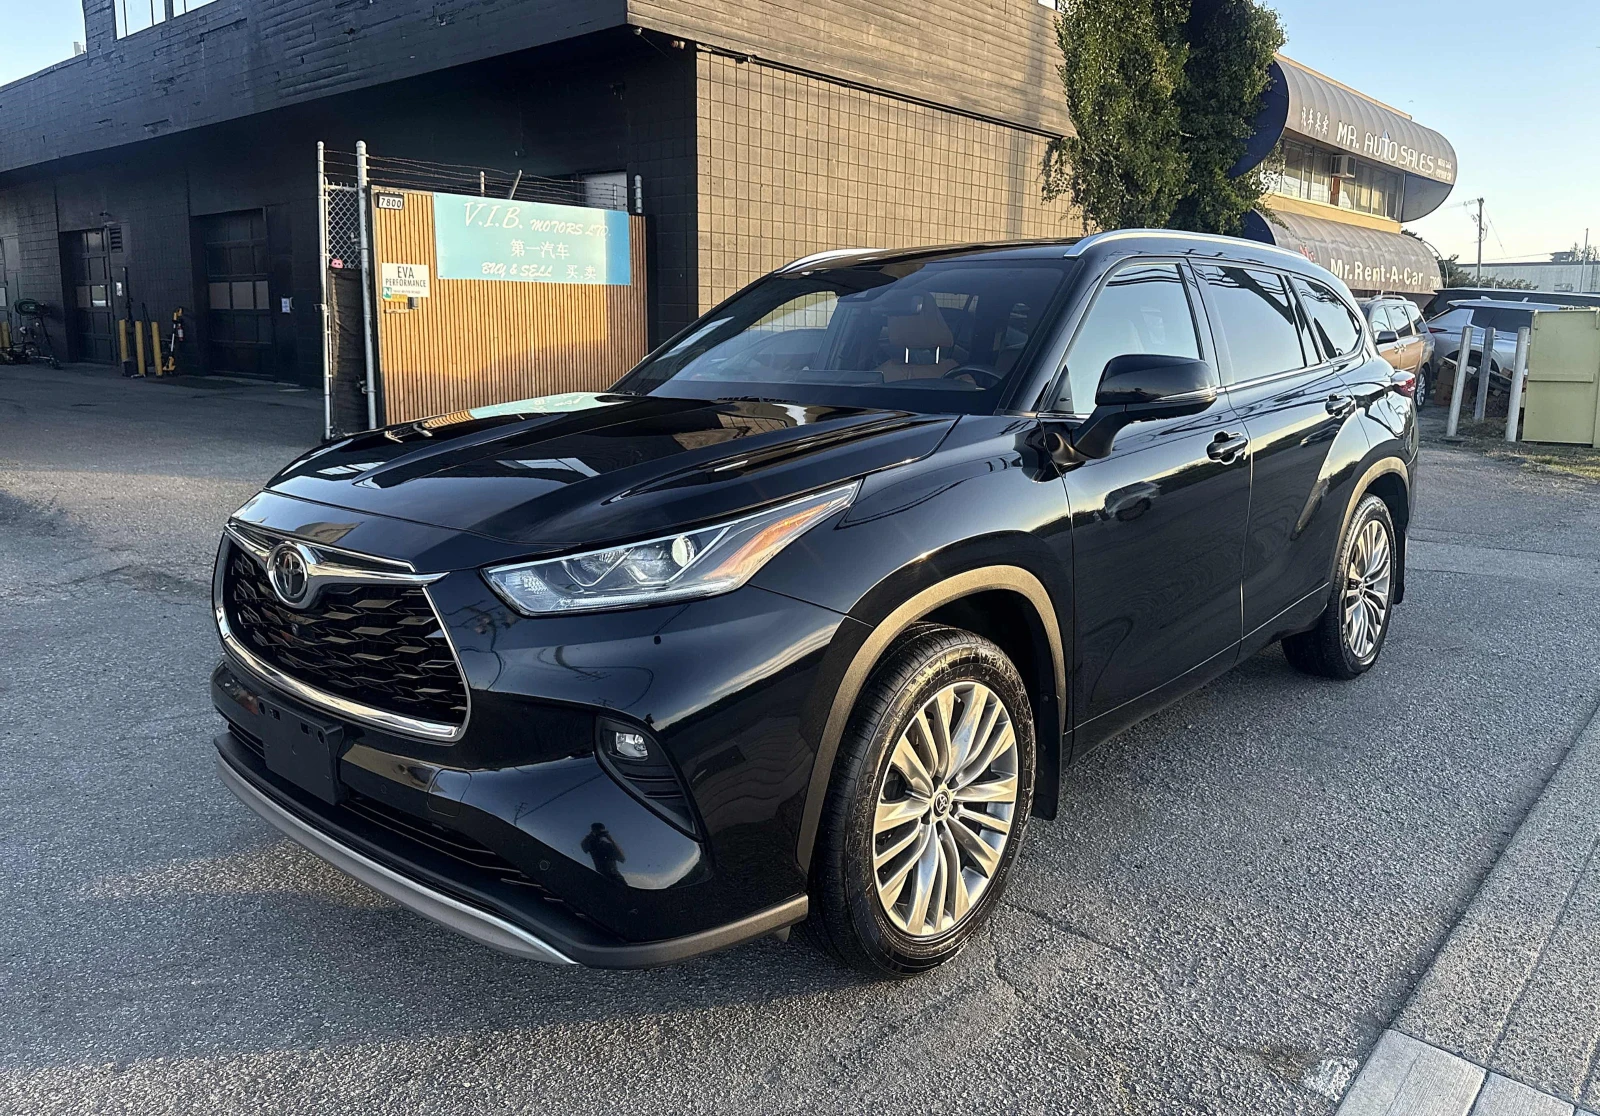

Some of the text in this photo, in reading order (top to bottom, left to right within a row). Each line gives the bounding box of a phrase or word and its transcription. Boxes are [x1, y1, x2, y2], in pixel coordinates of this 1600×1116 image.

[1336, 121, 1434, 173] MR. AUTO SALES
[380, 197, 402, 208] 7800
[463, 201, 523, 230] V.I.B.
[529, 219, 583, 236] MOTORS
[510, 239, 570, 260] 第一汽车
[397, 266, 415, 279] EVA
[481, 261, 553, 278] BUY & SELL
[385, 278, 427, 288] PERFORMANCE
